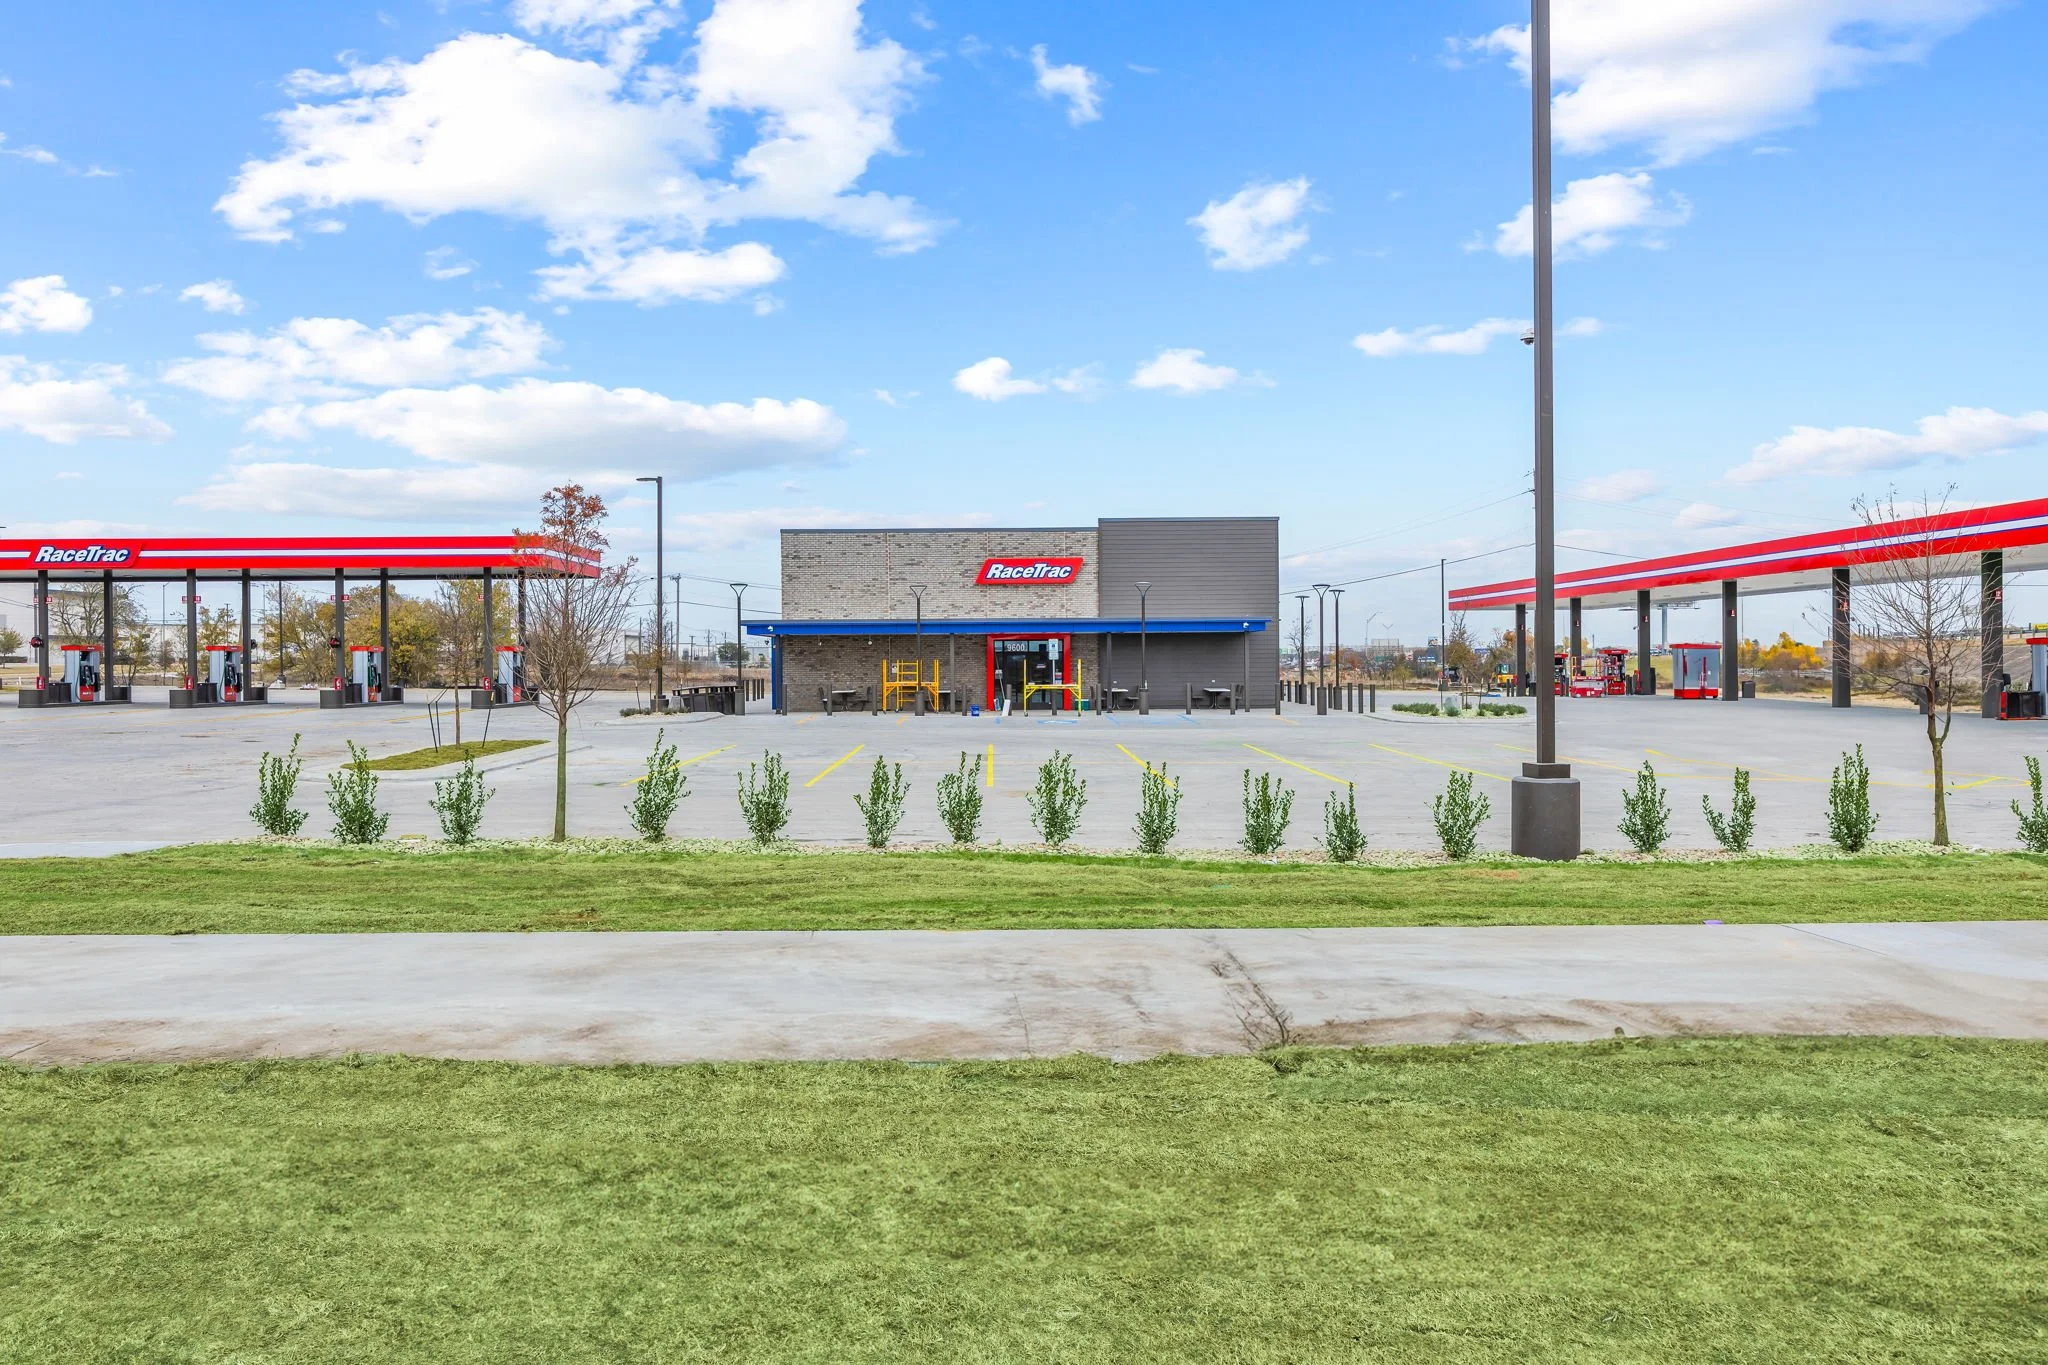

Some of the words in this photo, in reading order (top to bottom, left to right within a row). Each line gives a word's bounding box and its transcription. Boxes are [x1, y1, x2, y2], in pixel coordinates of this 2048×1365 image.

[35, 545, 129, 562] RaceTrac
[986, 563, 1072, 579] RaceTrac
[1007, 643, 1025, 652] 9600
